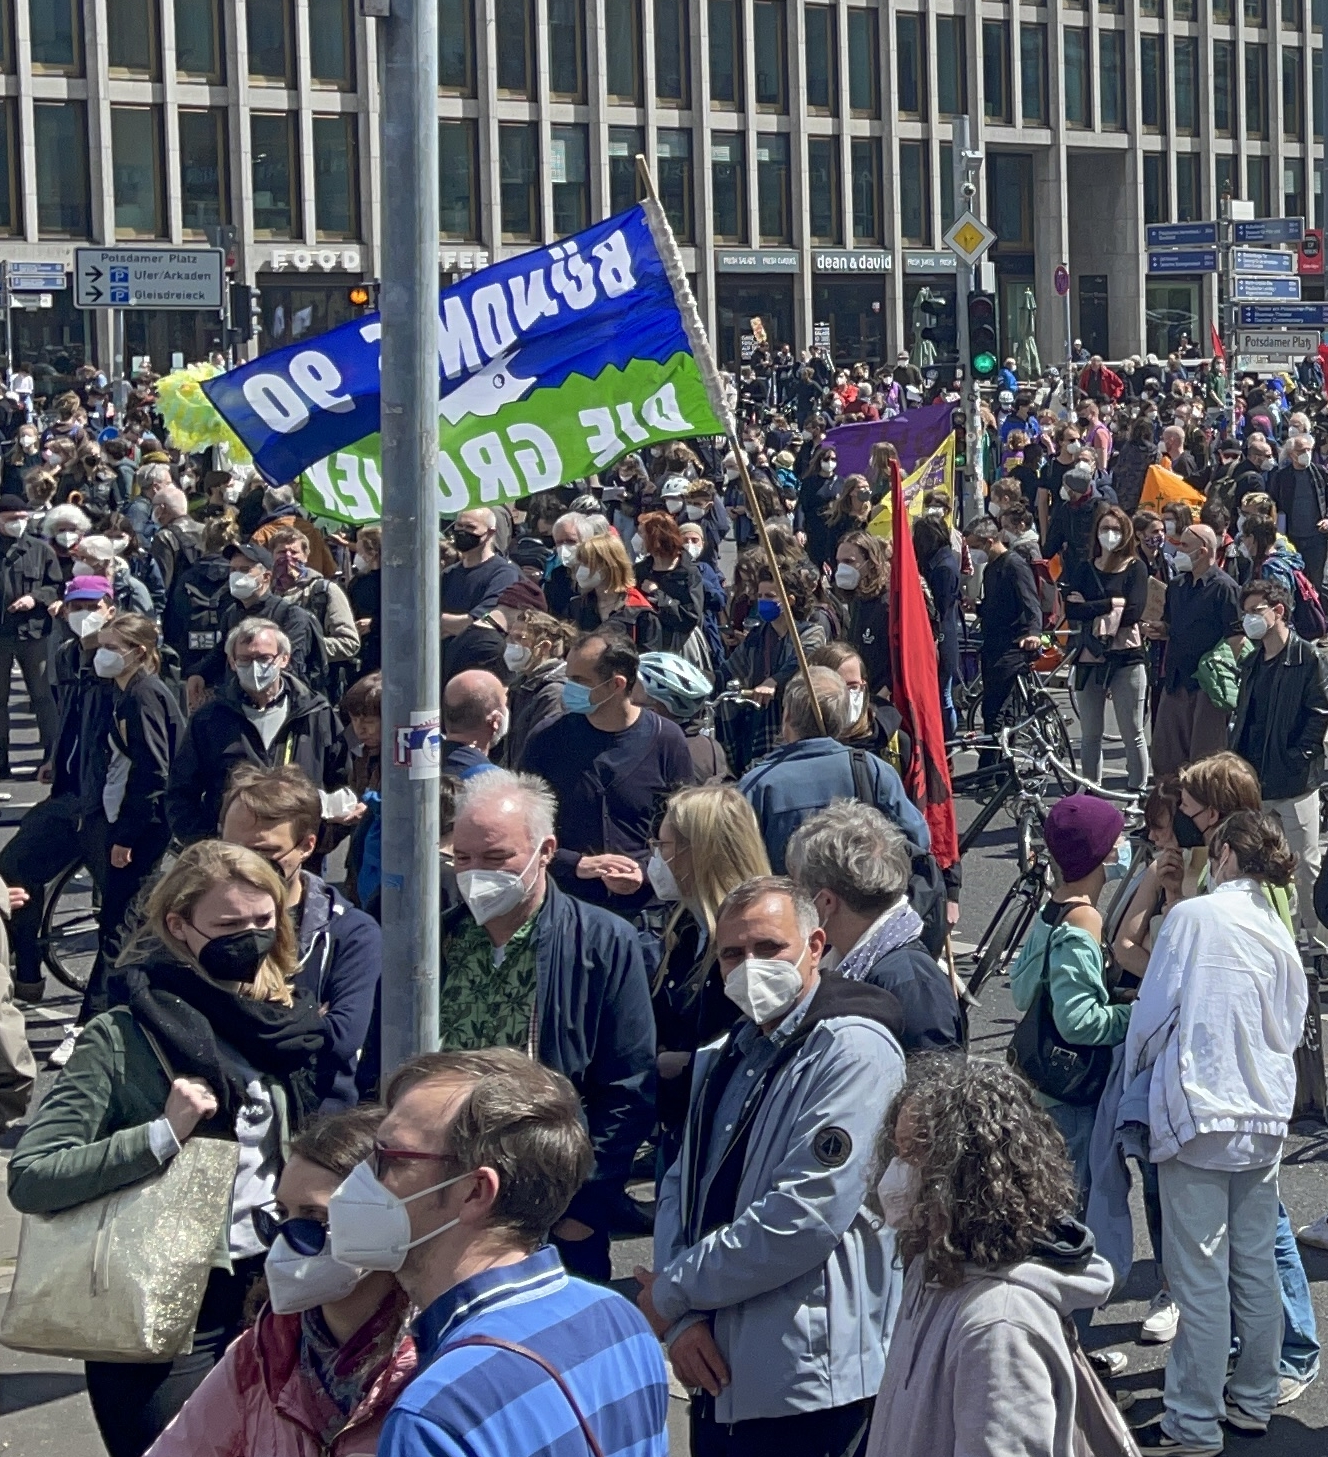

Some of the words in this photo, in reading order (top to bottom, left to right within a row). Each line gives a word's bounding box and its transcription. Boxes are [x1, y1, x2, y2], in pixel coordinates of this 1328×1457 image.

[101, 253, 164, 264] Potsdamer
[169, 253, 198, 264] Platz
[271, 250, 360, 271] FOOD
[439, 251, 489, 270] FEE
[817, 254, 848, 269] dean
[849, 257, 858, 269] &
[858, 254, 892, 269] david
[134, 270, 212, 281] Ufer/Arkaden
[134, 290, 206, 300] Gleisdreieck
[1245, 335, 1291, 348] Potsdamer
[1293, 335, 1312, 350] Platz
